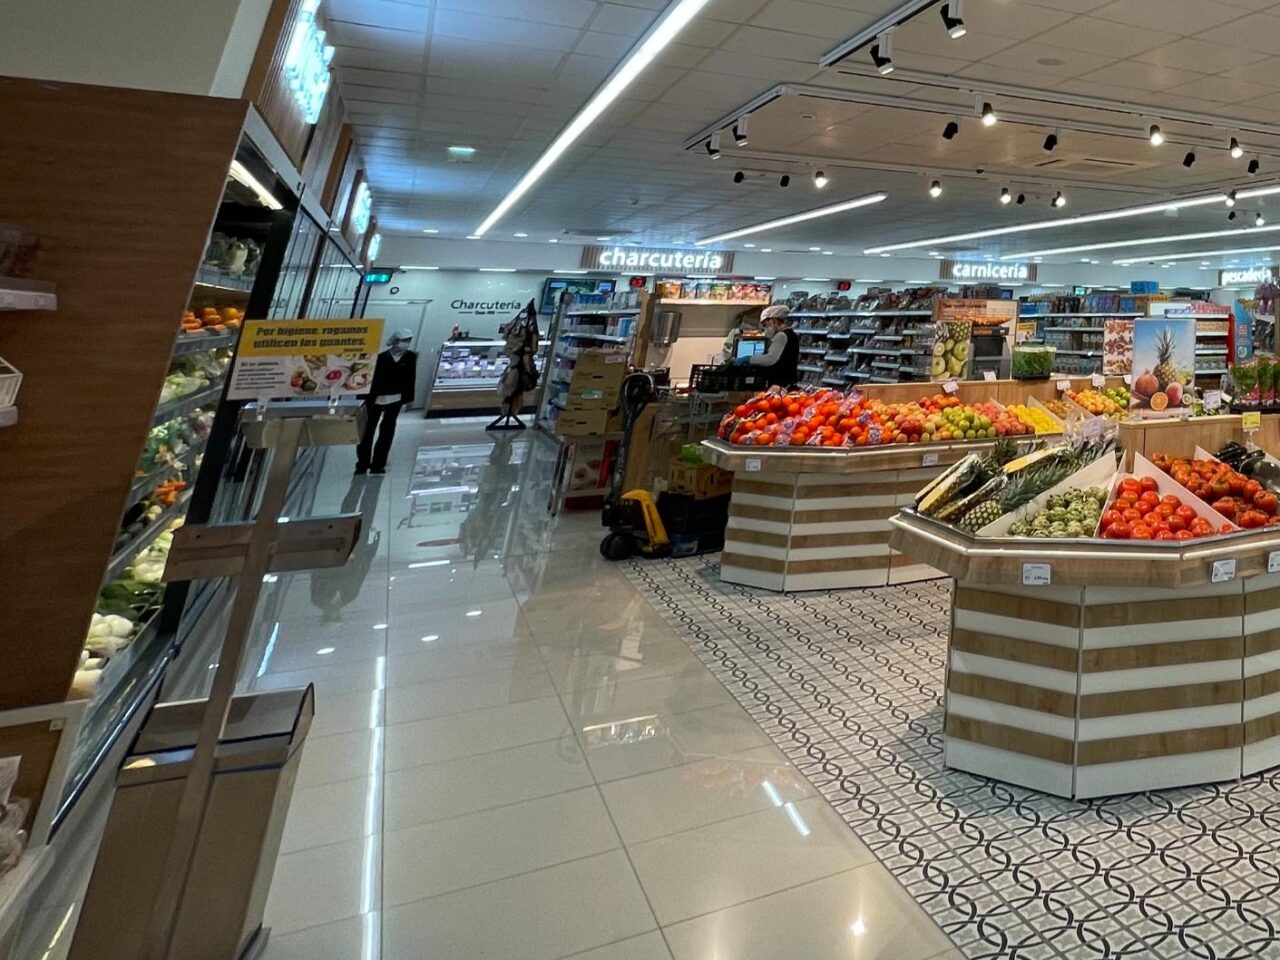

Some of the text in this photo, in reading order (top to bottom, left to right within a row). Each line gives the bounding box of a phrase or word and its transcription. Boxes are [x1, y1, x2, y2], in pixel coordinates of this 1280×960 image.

[599, 247, 722, 269] charcutería
[952, 263, 1028, 279] carnicería
[451, 300, 521, 310] Charcutería
[256, 327, 275, 337] Por
[322, 326, 368, 336] rogamos
[253, 339, 298, 349] utilicen
[300, 338, 317, 347] los
